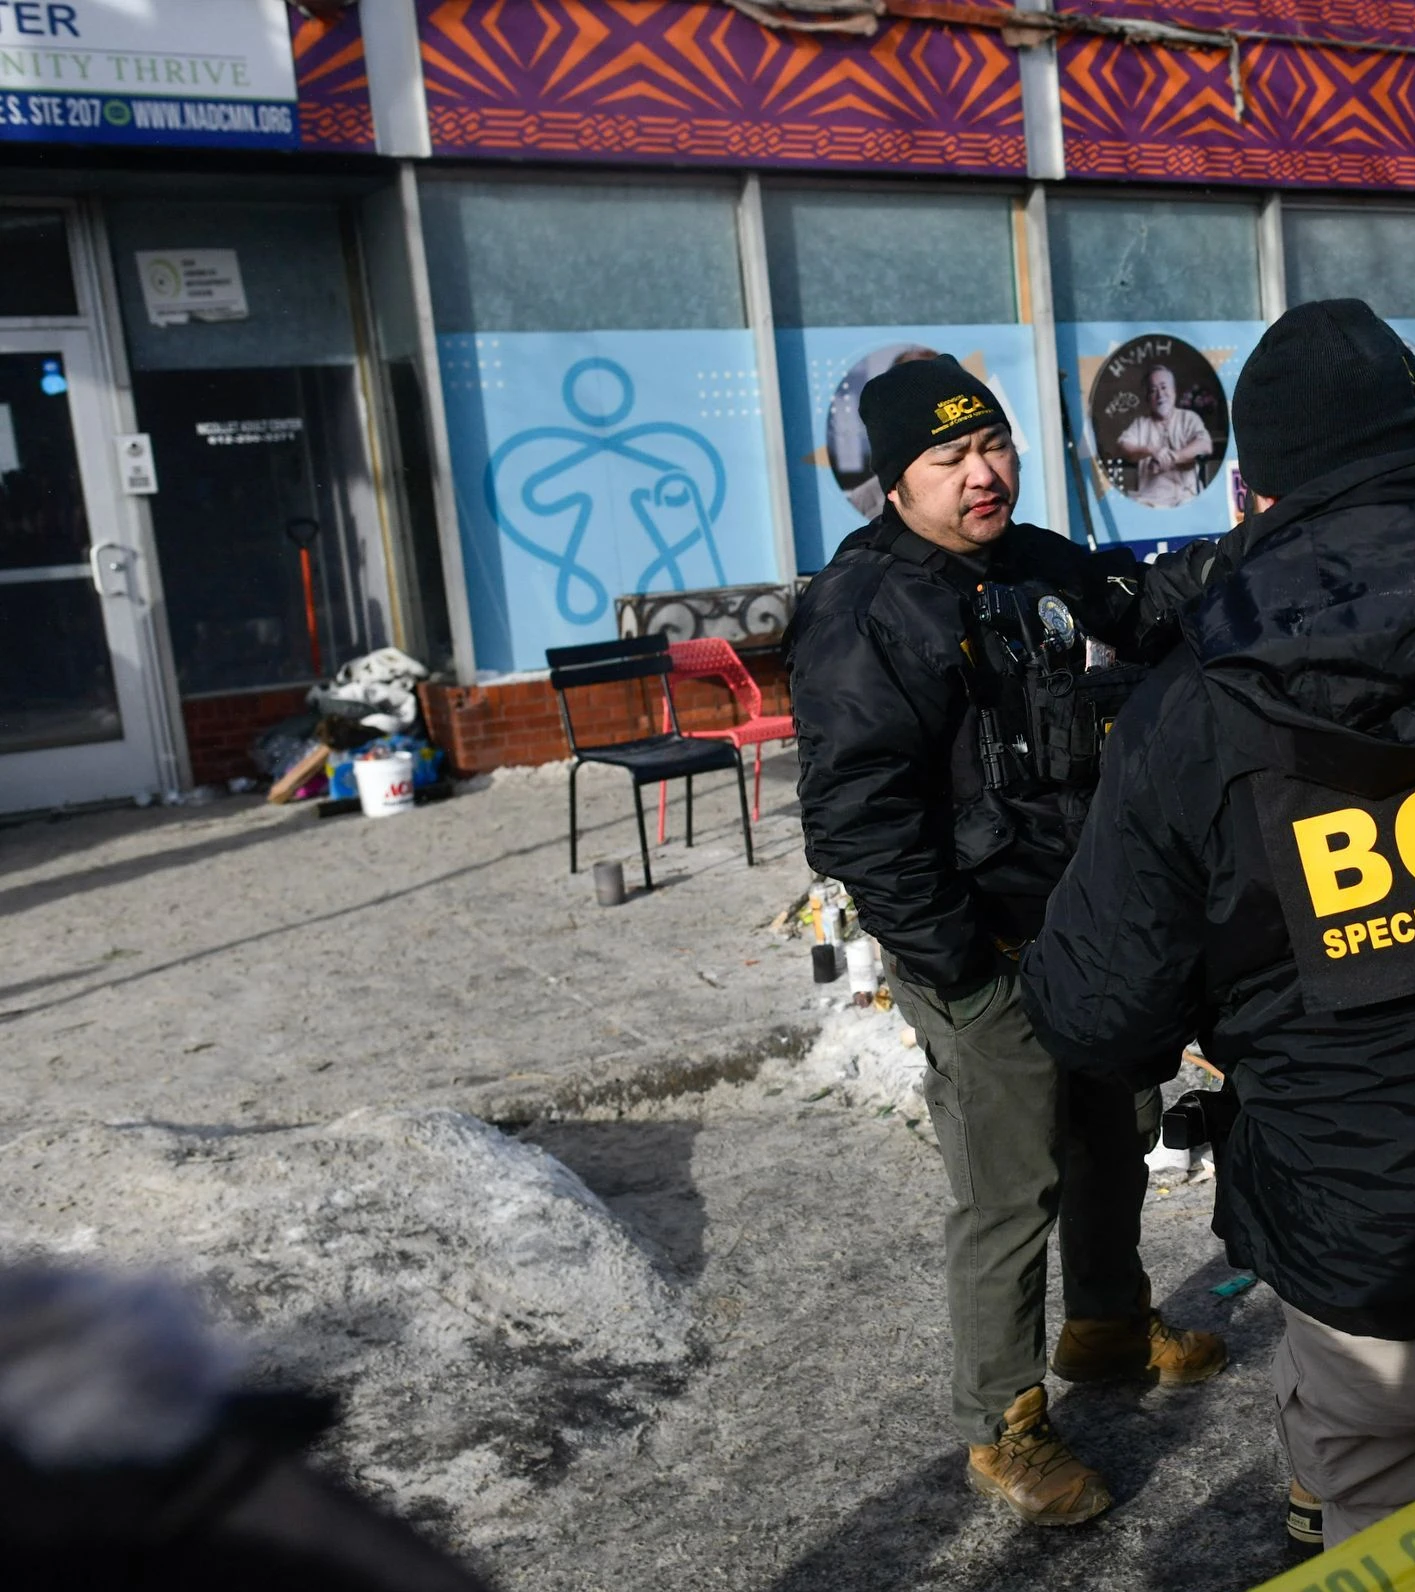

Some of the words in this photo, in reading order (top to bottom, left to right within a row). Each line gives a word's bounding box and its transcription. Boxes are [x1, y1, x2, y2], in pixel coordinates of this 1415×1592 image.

[107, 55, 250, 87] THRIVE
[7, 95, 28, 125] S.
[29, 96, 65, 126] STE
[66, 97, 101, 127] 207
[944, 395, 986, 420] BCA
